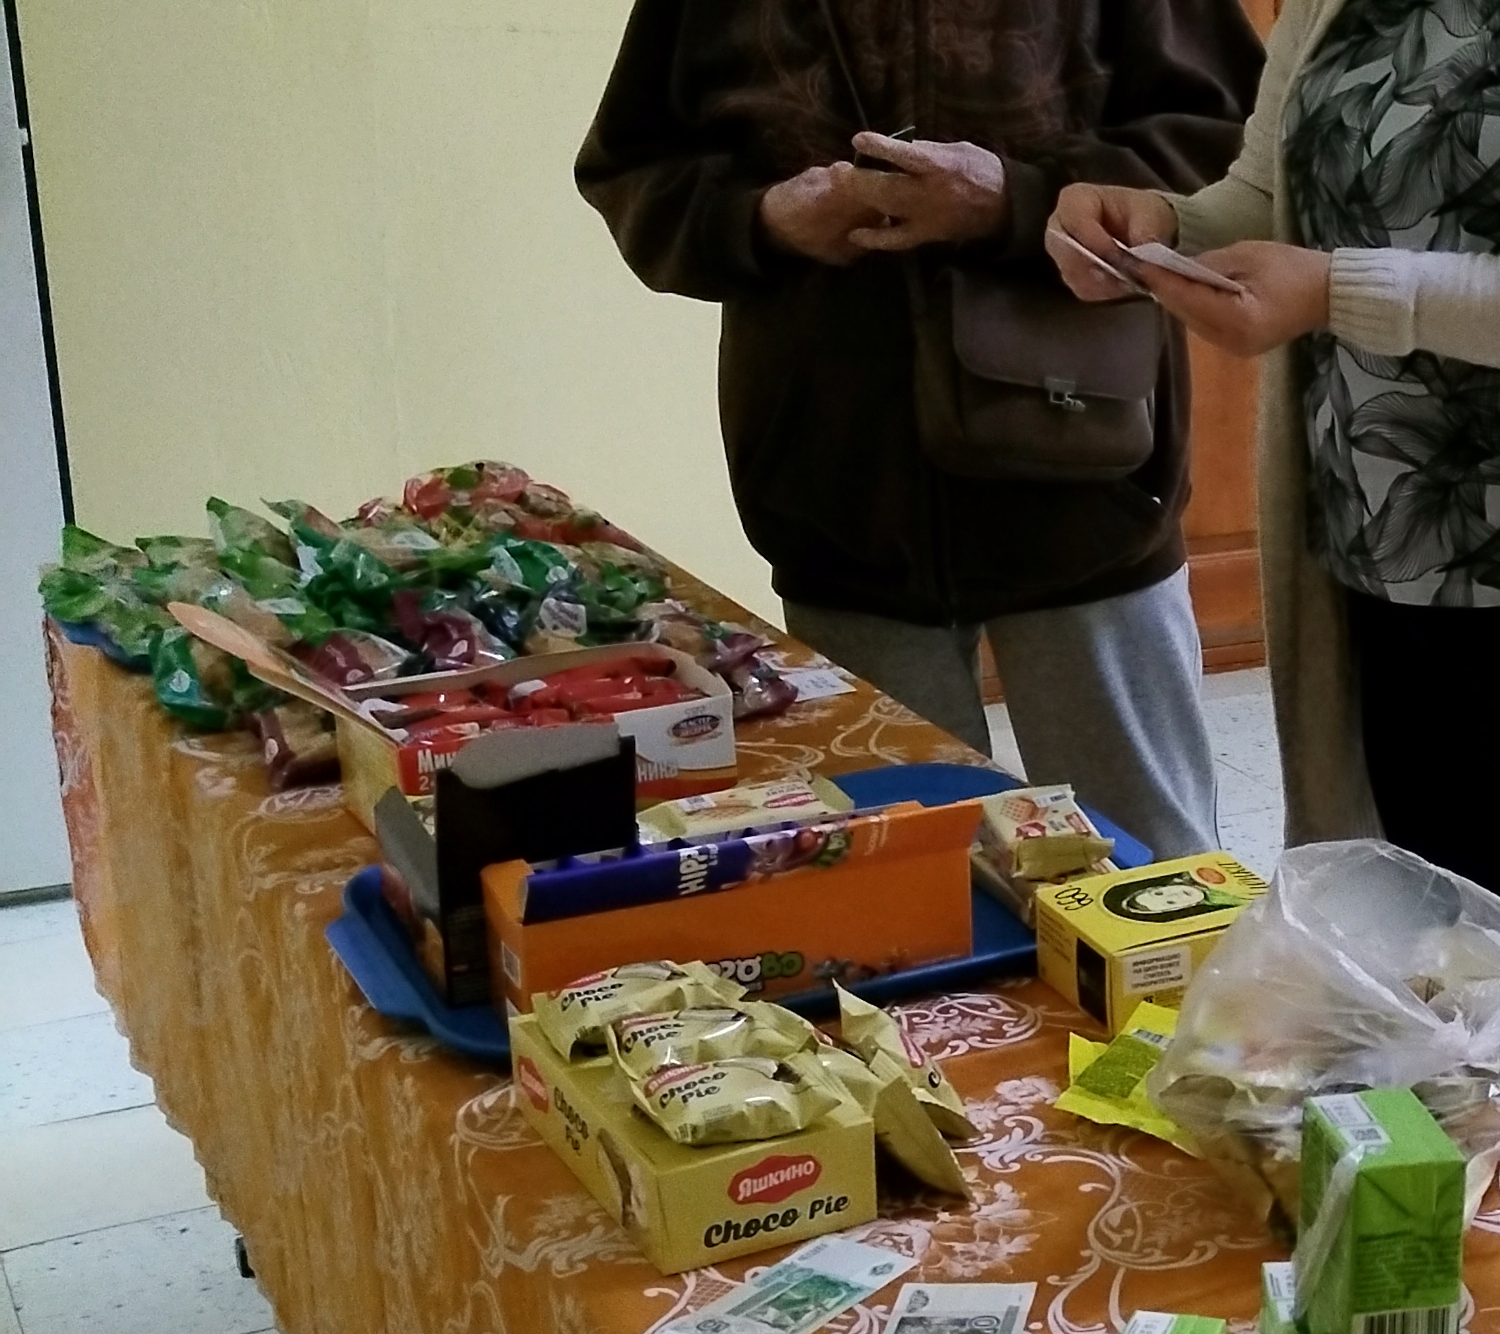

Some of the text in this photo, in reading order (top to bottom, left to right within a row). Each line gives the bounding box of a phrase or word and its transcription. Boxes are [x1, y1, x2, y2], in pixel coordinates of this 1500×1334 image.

[560, 982, 624, 1011] Choco
[579, 991, 617, 1008] Pie
[643, 1029, 681, 1048] Pie
[659, 1071, 728, 1109] Choco
[681, 1085, 721, 1104] Pie
[703, 1195, 849, 1248] Choco Pie
